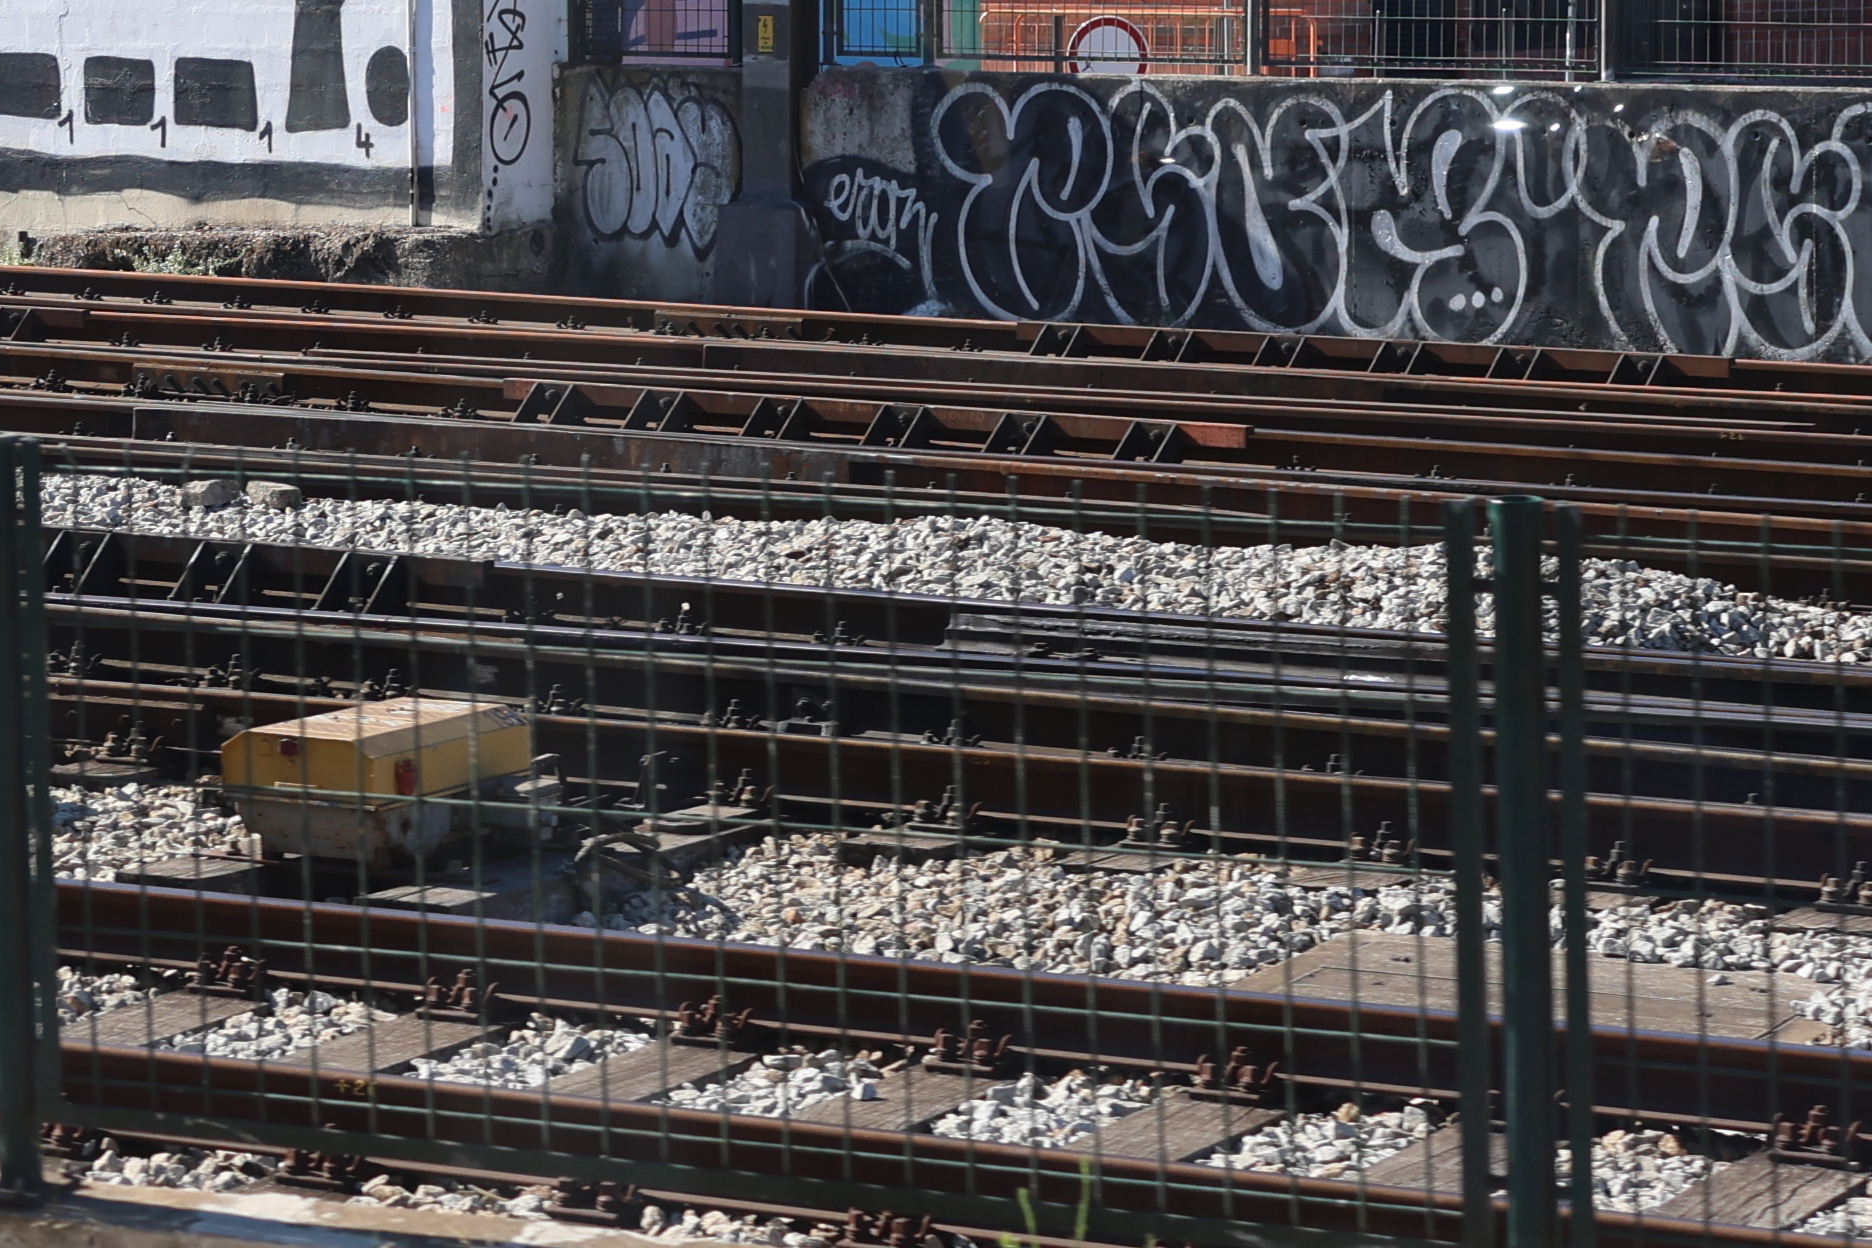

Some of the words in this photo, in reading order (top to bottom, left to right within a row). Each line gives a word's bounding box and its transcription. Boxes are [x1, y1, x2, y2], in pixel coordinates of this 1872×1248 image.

[58, 109, 75, 145] 1
[150, 115, 167, 148] 1
[259, 120, 274, 154] 1
[355, 122, 375, 158] 4
